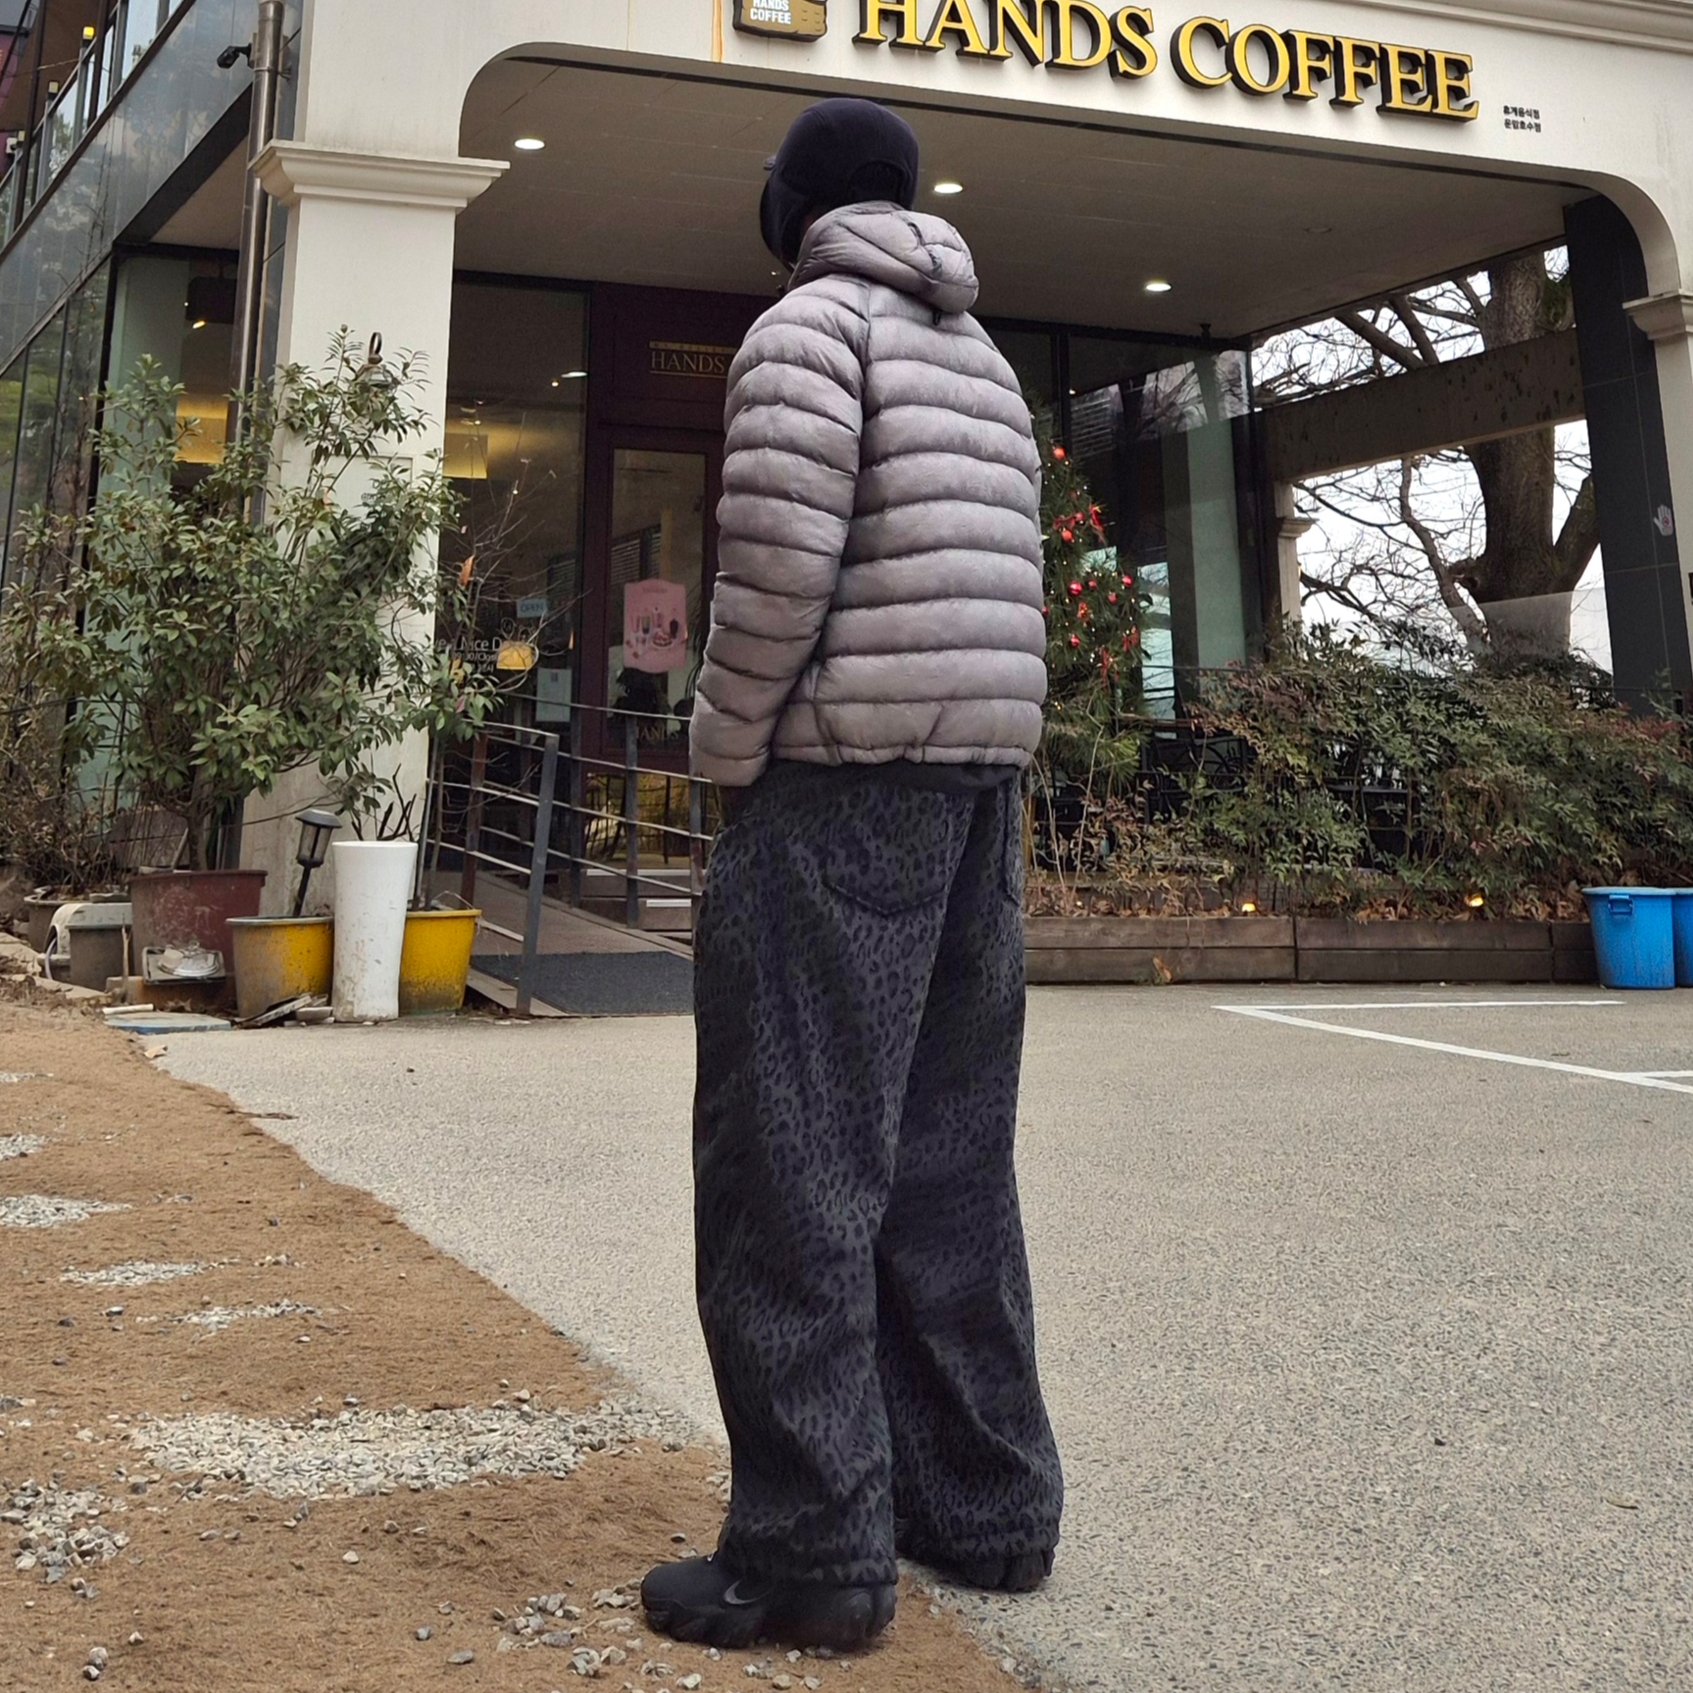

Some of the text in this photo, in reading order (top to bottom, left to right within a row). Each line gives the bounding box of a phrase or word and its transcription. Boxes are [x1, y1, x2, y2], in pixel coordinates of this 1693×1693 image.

[752, 0, 789, 11] HANDS
[750, 8, 791, 25] COFFEE
[852, 0, 1479, 122] HANDS COFFEE
[651, 351, 725, 373] HANDS
[520, 603, 544, 613] OPEN
